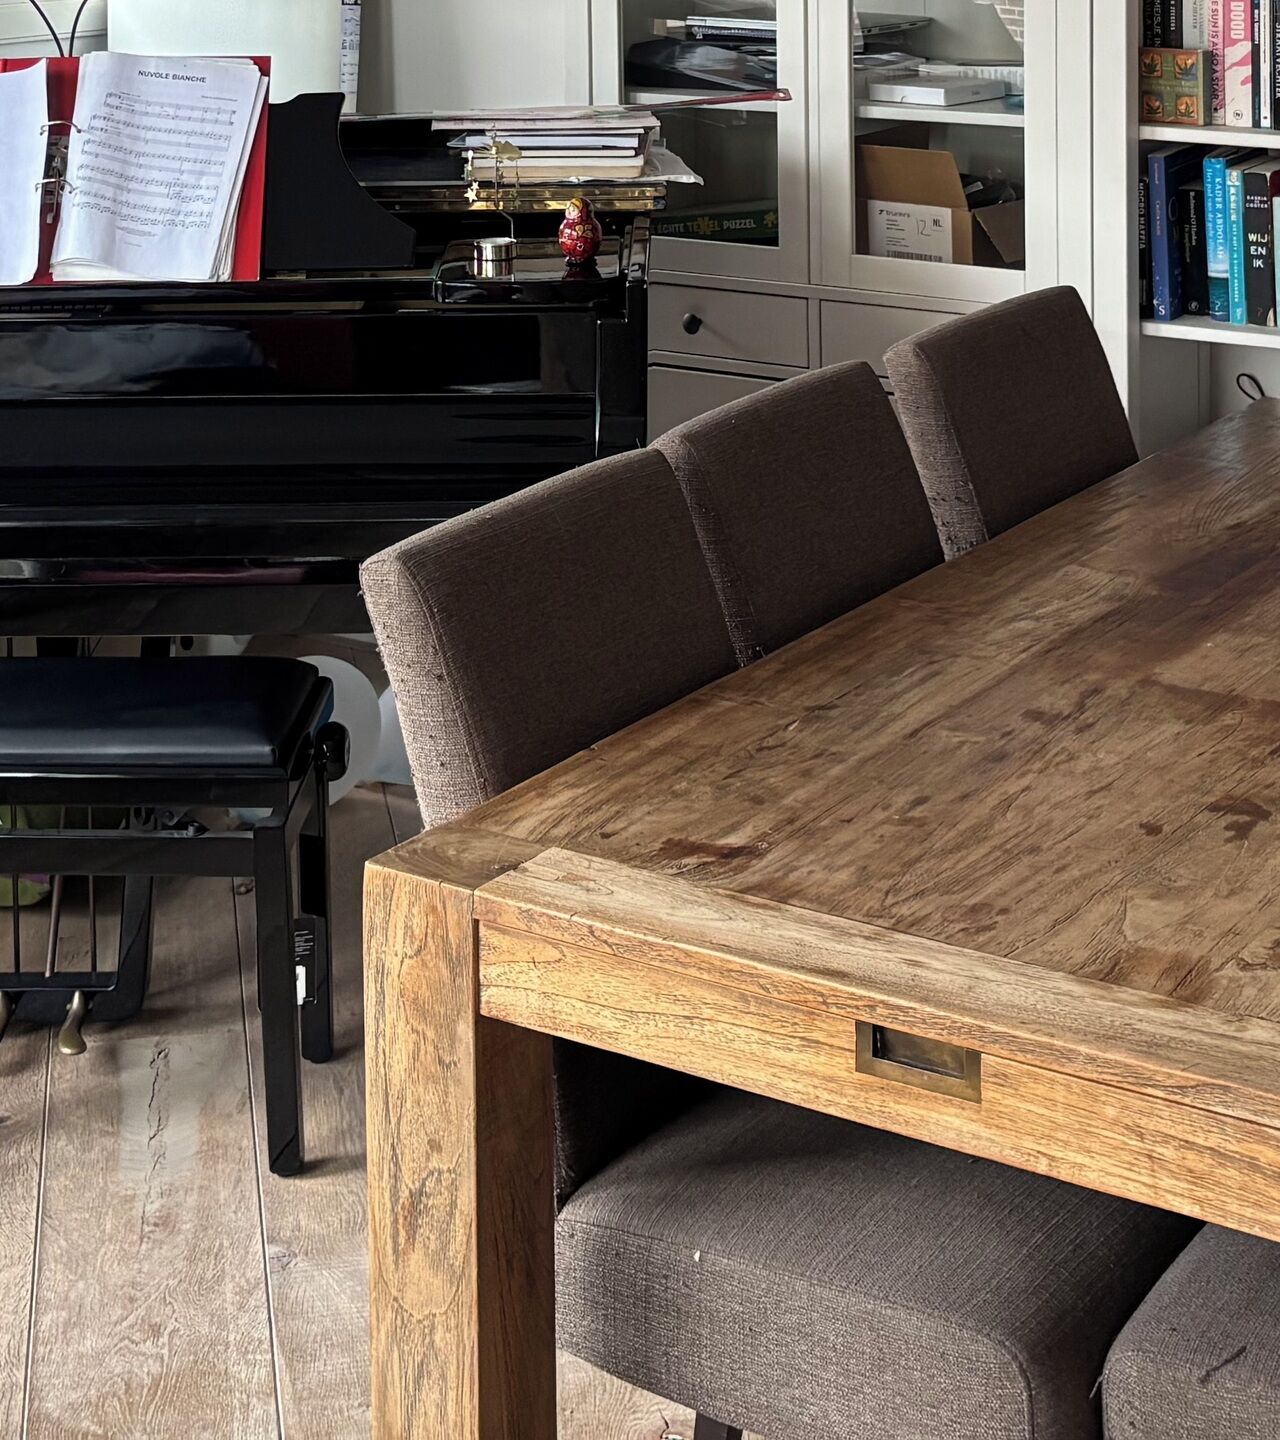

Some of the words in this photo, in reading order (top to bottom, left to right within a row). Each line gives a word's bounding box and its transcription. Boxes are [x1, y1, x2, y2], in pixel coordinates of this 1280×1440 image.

[1211, 8, 1219, 27] SUN
[1230, 2, 1244, 39] DOOD
[1211, 30, 1218, 38] IS
[138, 70, 170, 79] NUVOLE
[172, 74, 207, 83] BIANCHE
[1215, 178, 1223, 209] KADER
[687, 217, 721, 235] TEXEL
[723, 218, 756, 232] PUZZEL
[933, 217, 943, 227] NL
[1216, 212, 1224, 259] ABDOLAH
[1248, 233, 1267, 242] WIJ
[1250, 246, 1266, 255] EN
[1253, 259, 1264, 268] IK
